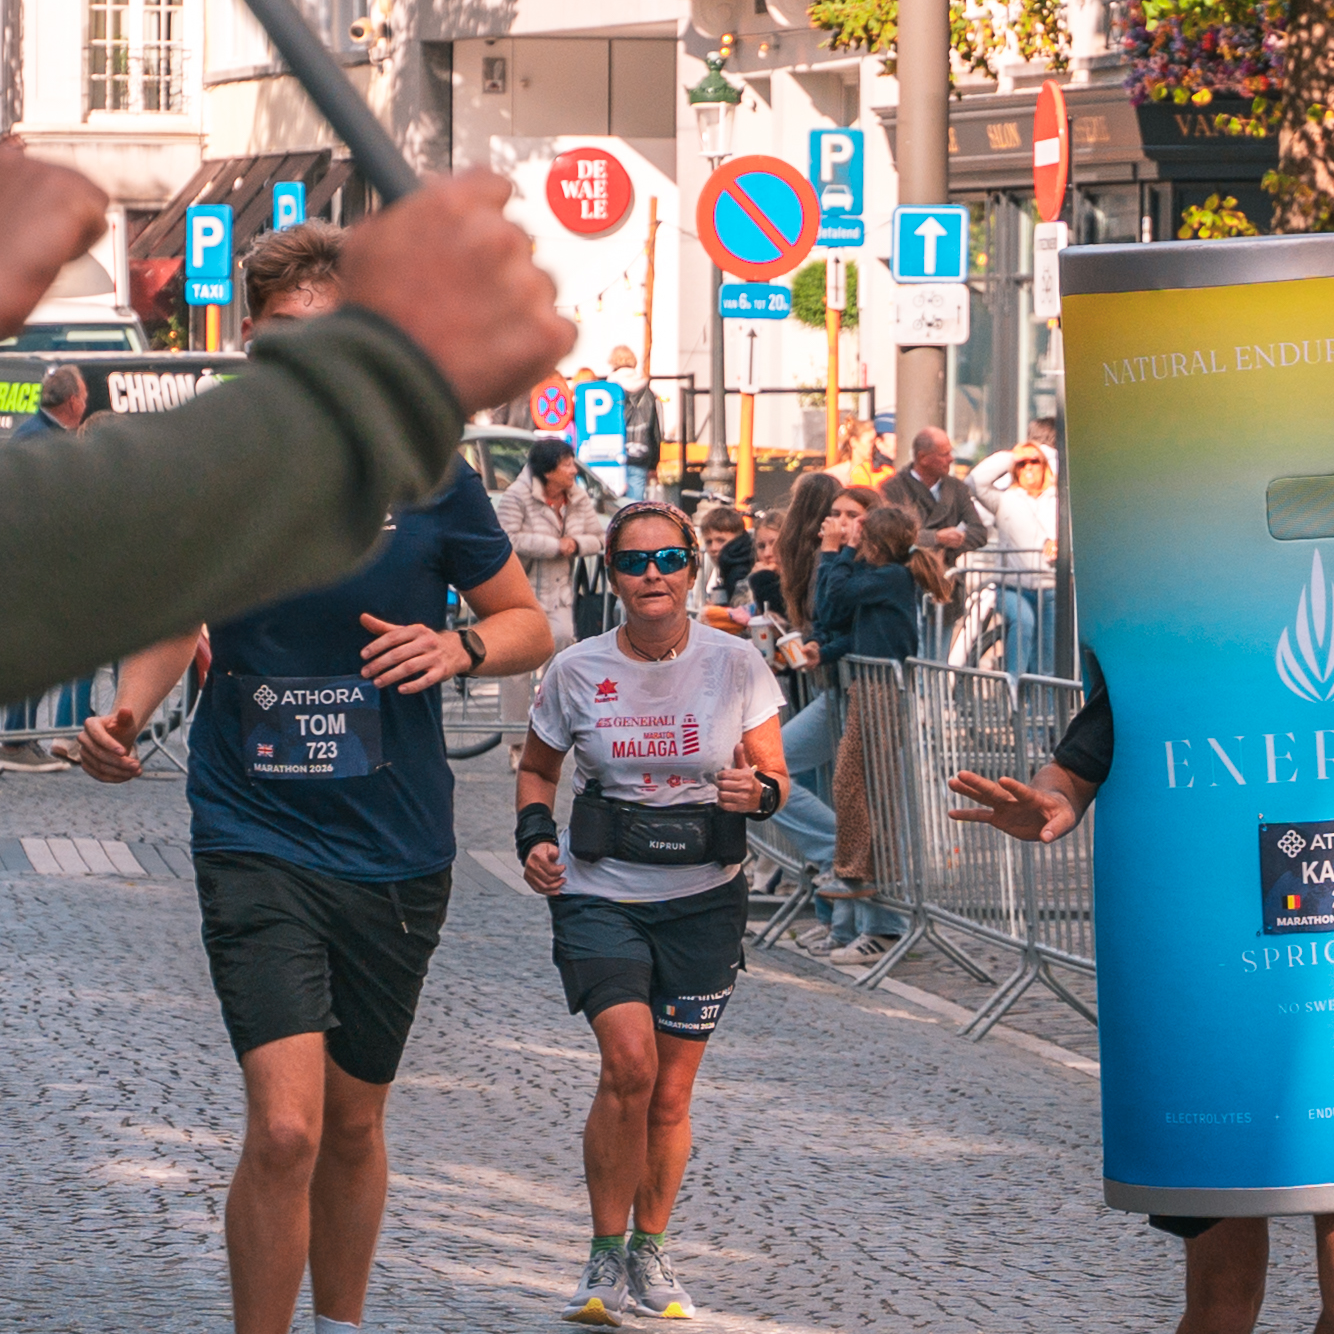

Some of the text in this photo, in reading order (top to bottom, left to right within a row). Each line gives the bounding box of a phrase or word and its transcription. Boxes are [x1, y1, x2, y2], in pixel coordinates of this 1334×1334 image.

[820, 133, 856, 183] P
[577, 159, 608, 179] DE
[560, 179, 608, 199] WAE
[278, 194, 298, 228] P
[580, 199, 608, 219] LE
[192, 216, 225, 268] P
[192, 283, 225, 299] TAXI
[722, 298, 738, 310] VAN
[1103, 349, 1226, 387] NATURAL
[584, 388, 614, 435] P
[281, 687, 365, 706] ATHORA
[295, 713, 347, 737] TOM
[613, 715, 676, 727] GENERALI
[306, 741, 338, 760] 723
[612, 737, 678, 758] MÁLAGA
[253, 763, 334, 774] MARATHON 2026
[649, 840, 686, 851] KIPRUN
[700, 1004, 720, 1020] 377
[1278, 1002, 1300, 1015] NO
[658, 1018, 699, 1030] MARATHON
[1165, 1112, 1252, 1124] ELECTROLYTES
